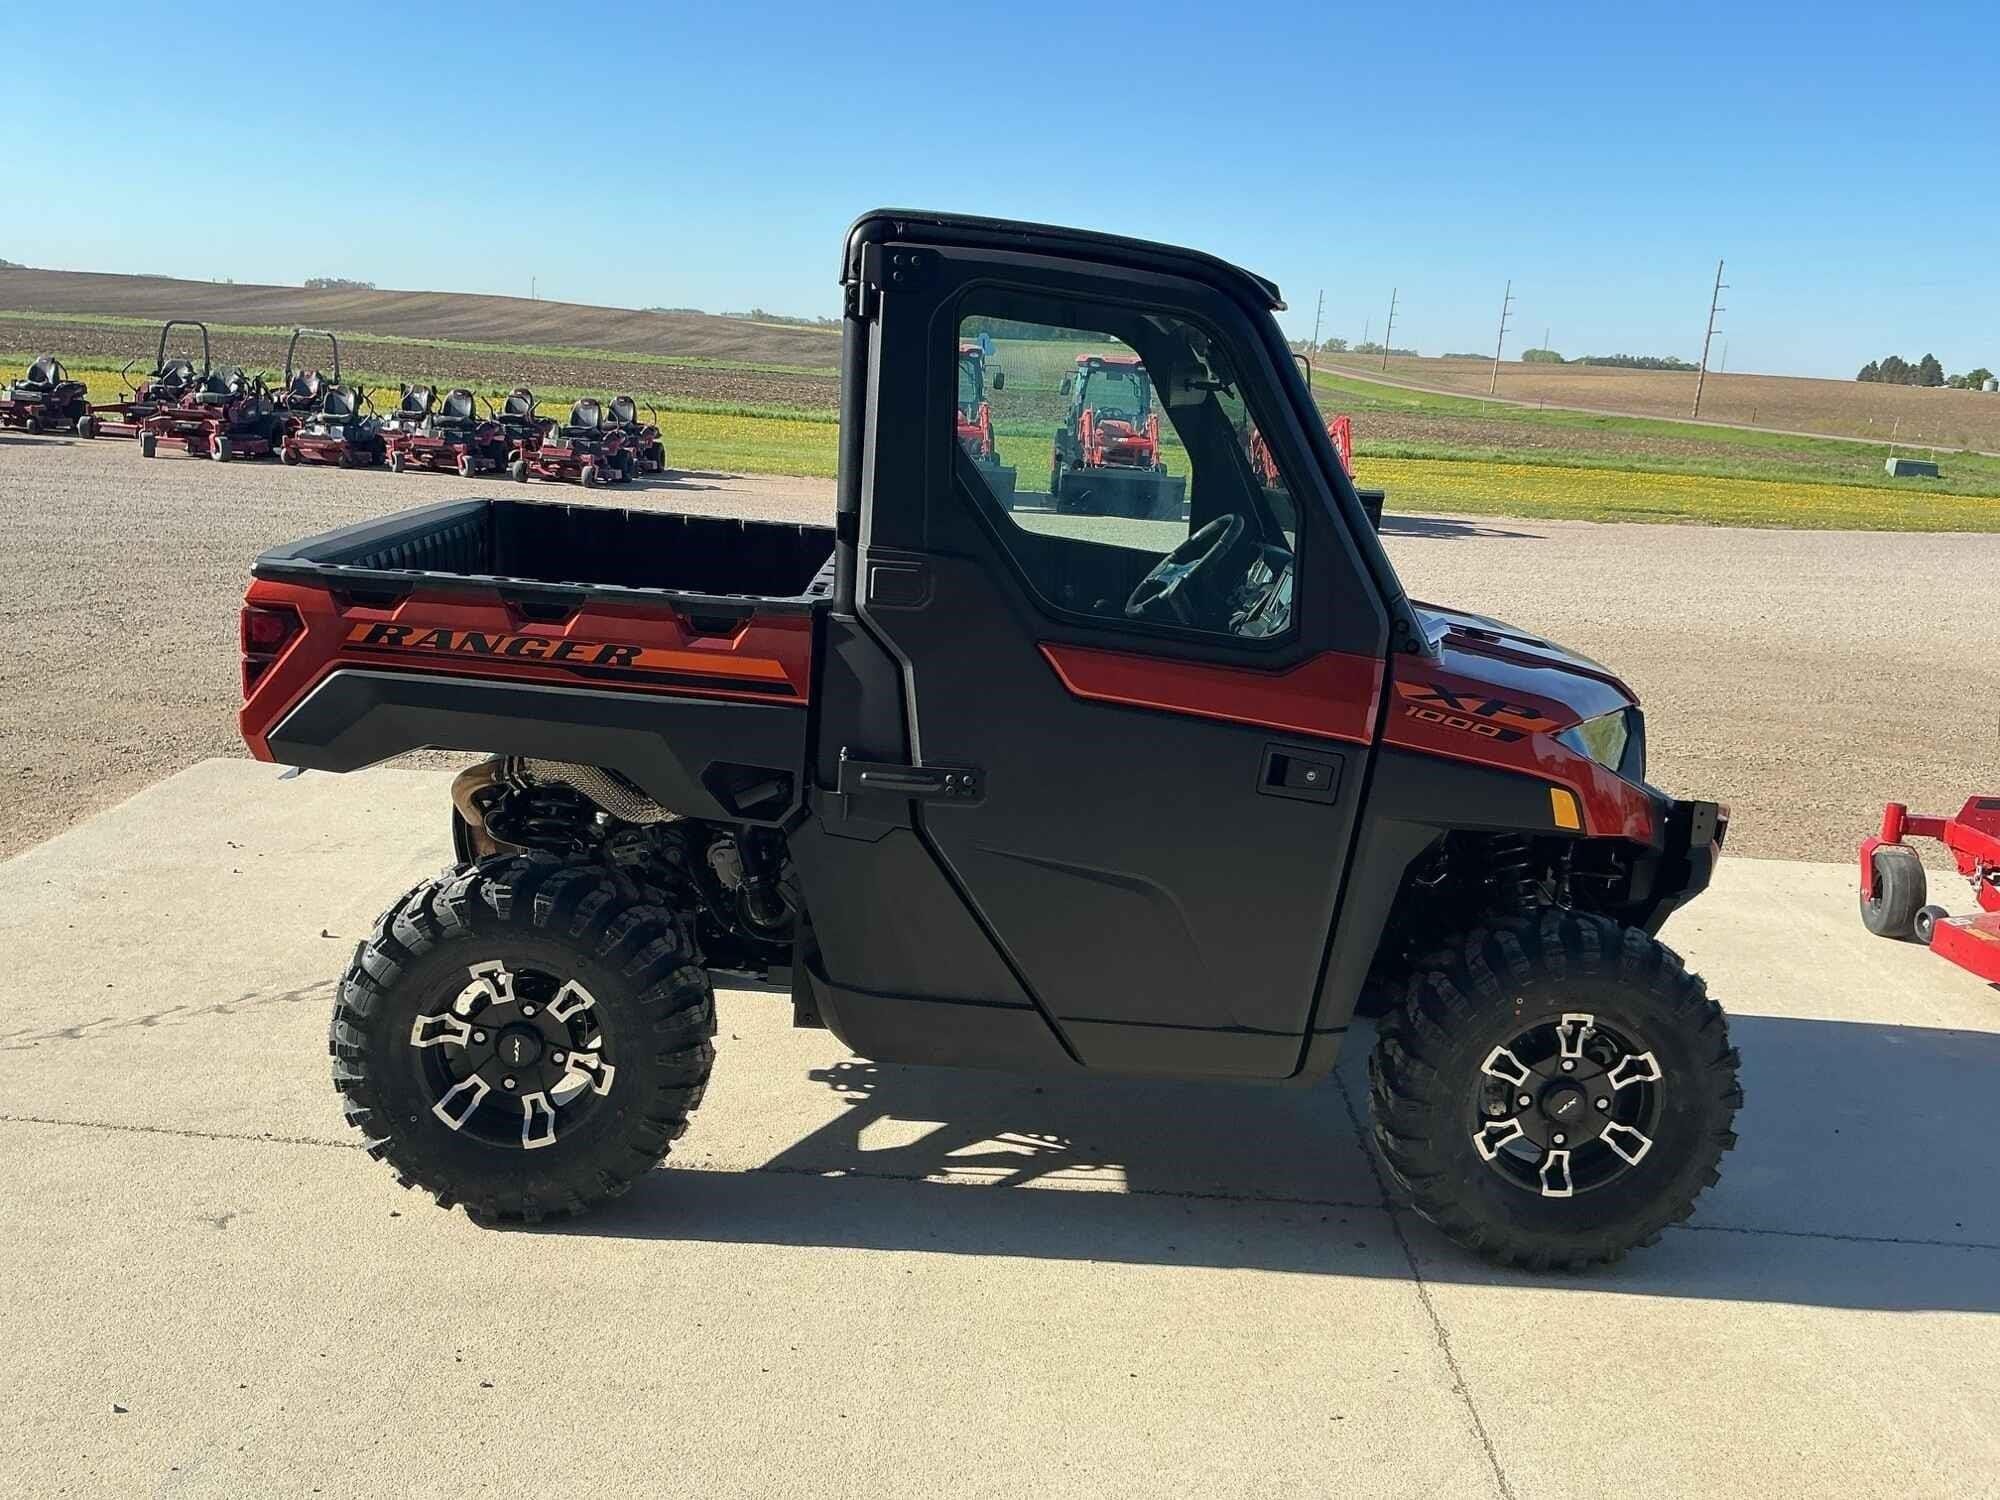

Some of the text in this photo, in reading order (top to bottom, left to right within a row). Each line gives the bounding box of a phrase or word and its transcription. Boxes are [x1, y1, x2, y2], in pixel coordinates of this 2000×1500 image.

[361, 623, 643, 666] RANGER
[1402, 683, 1542, 718] XP
[1405, 706, 1501, 737] 1000
